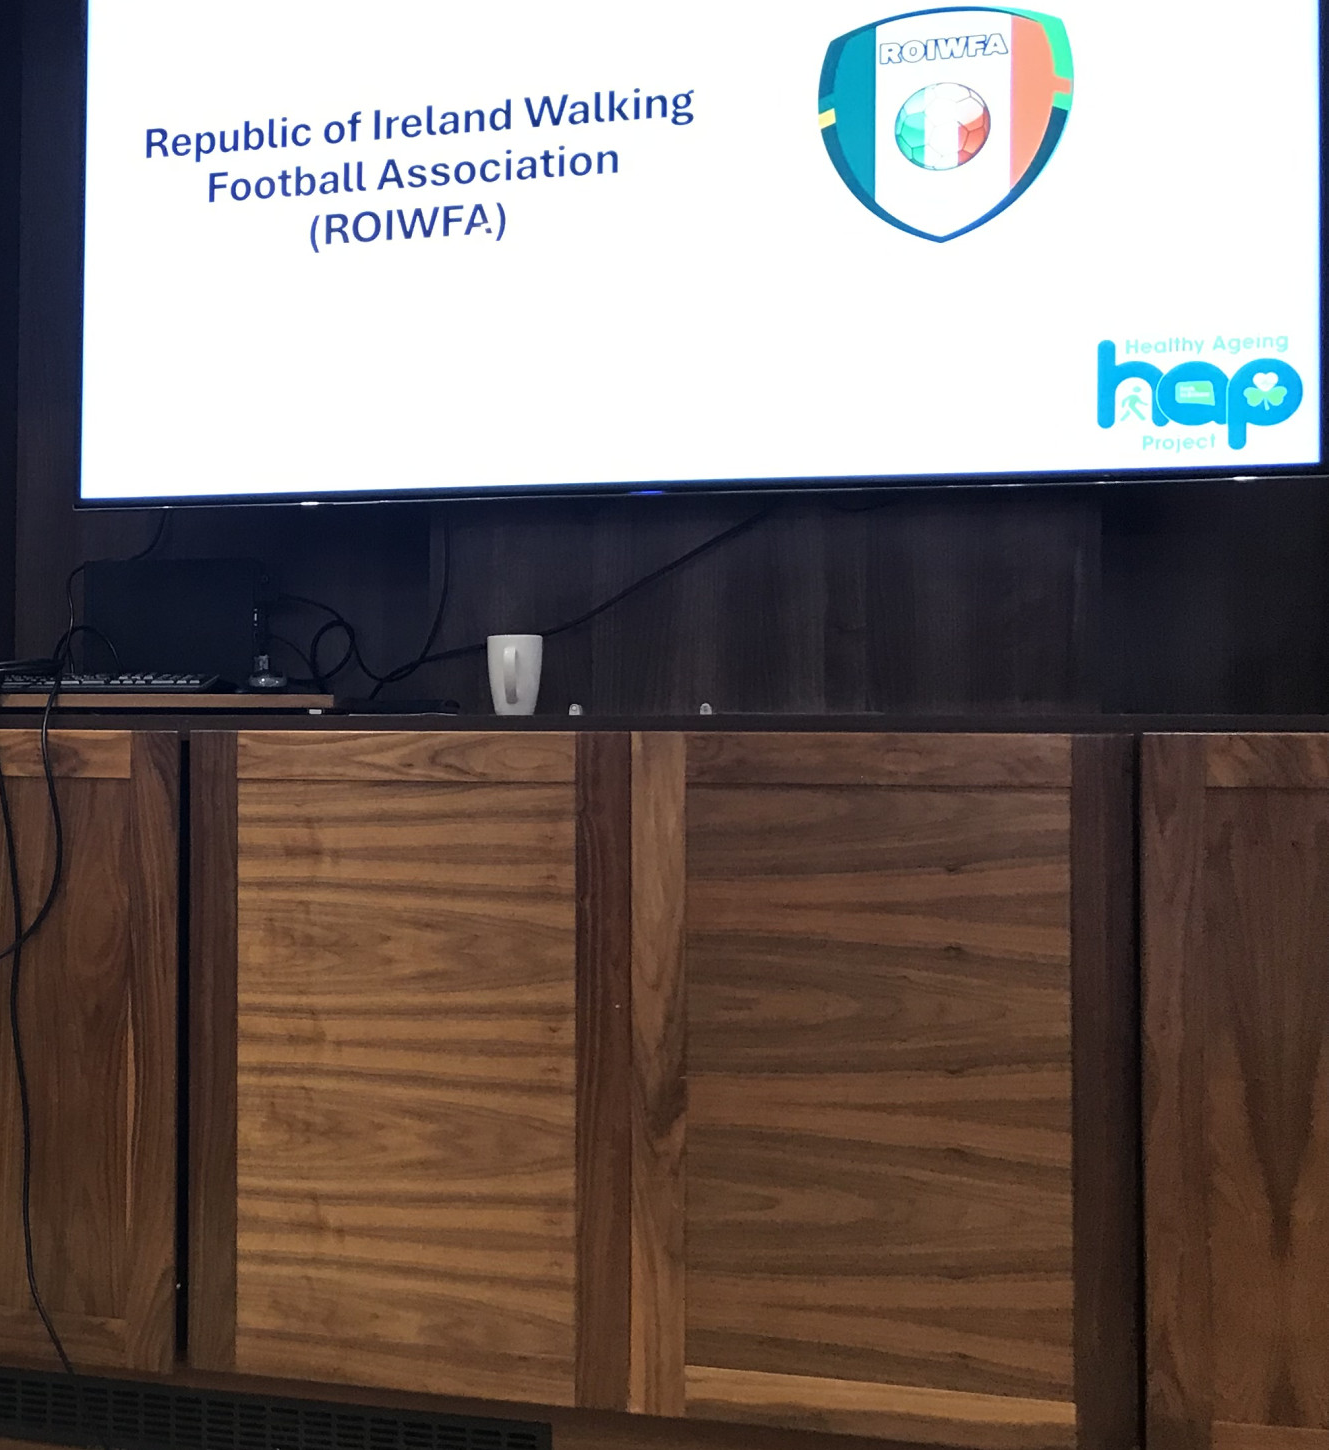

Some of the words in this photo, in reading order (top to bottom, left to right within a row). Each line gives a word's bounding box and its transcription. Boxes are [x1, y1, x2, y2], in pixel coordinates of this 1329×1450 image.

[880, 34, 1009, 65] ROIWFA
[145, 117, 312, 163] Republic
[323, 110, 362, 145] of
[373, 99, 512, 142] Ireland
[524, 88, 695, 129] Walking
[208, 161, 367, 203] Football
[377, 145, 619, 191] Association
[309, 202, 507, 254] (ROIWFA)
[1125, 337, 1205, 354] Healthy
[1212, 335, 1289, 354] Ageing
[1097, 339, 1304, 450] hap
[1142, 433, 1216, 453] Project
